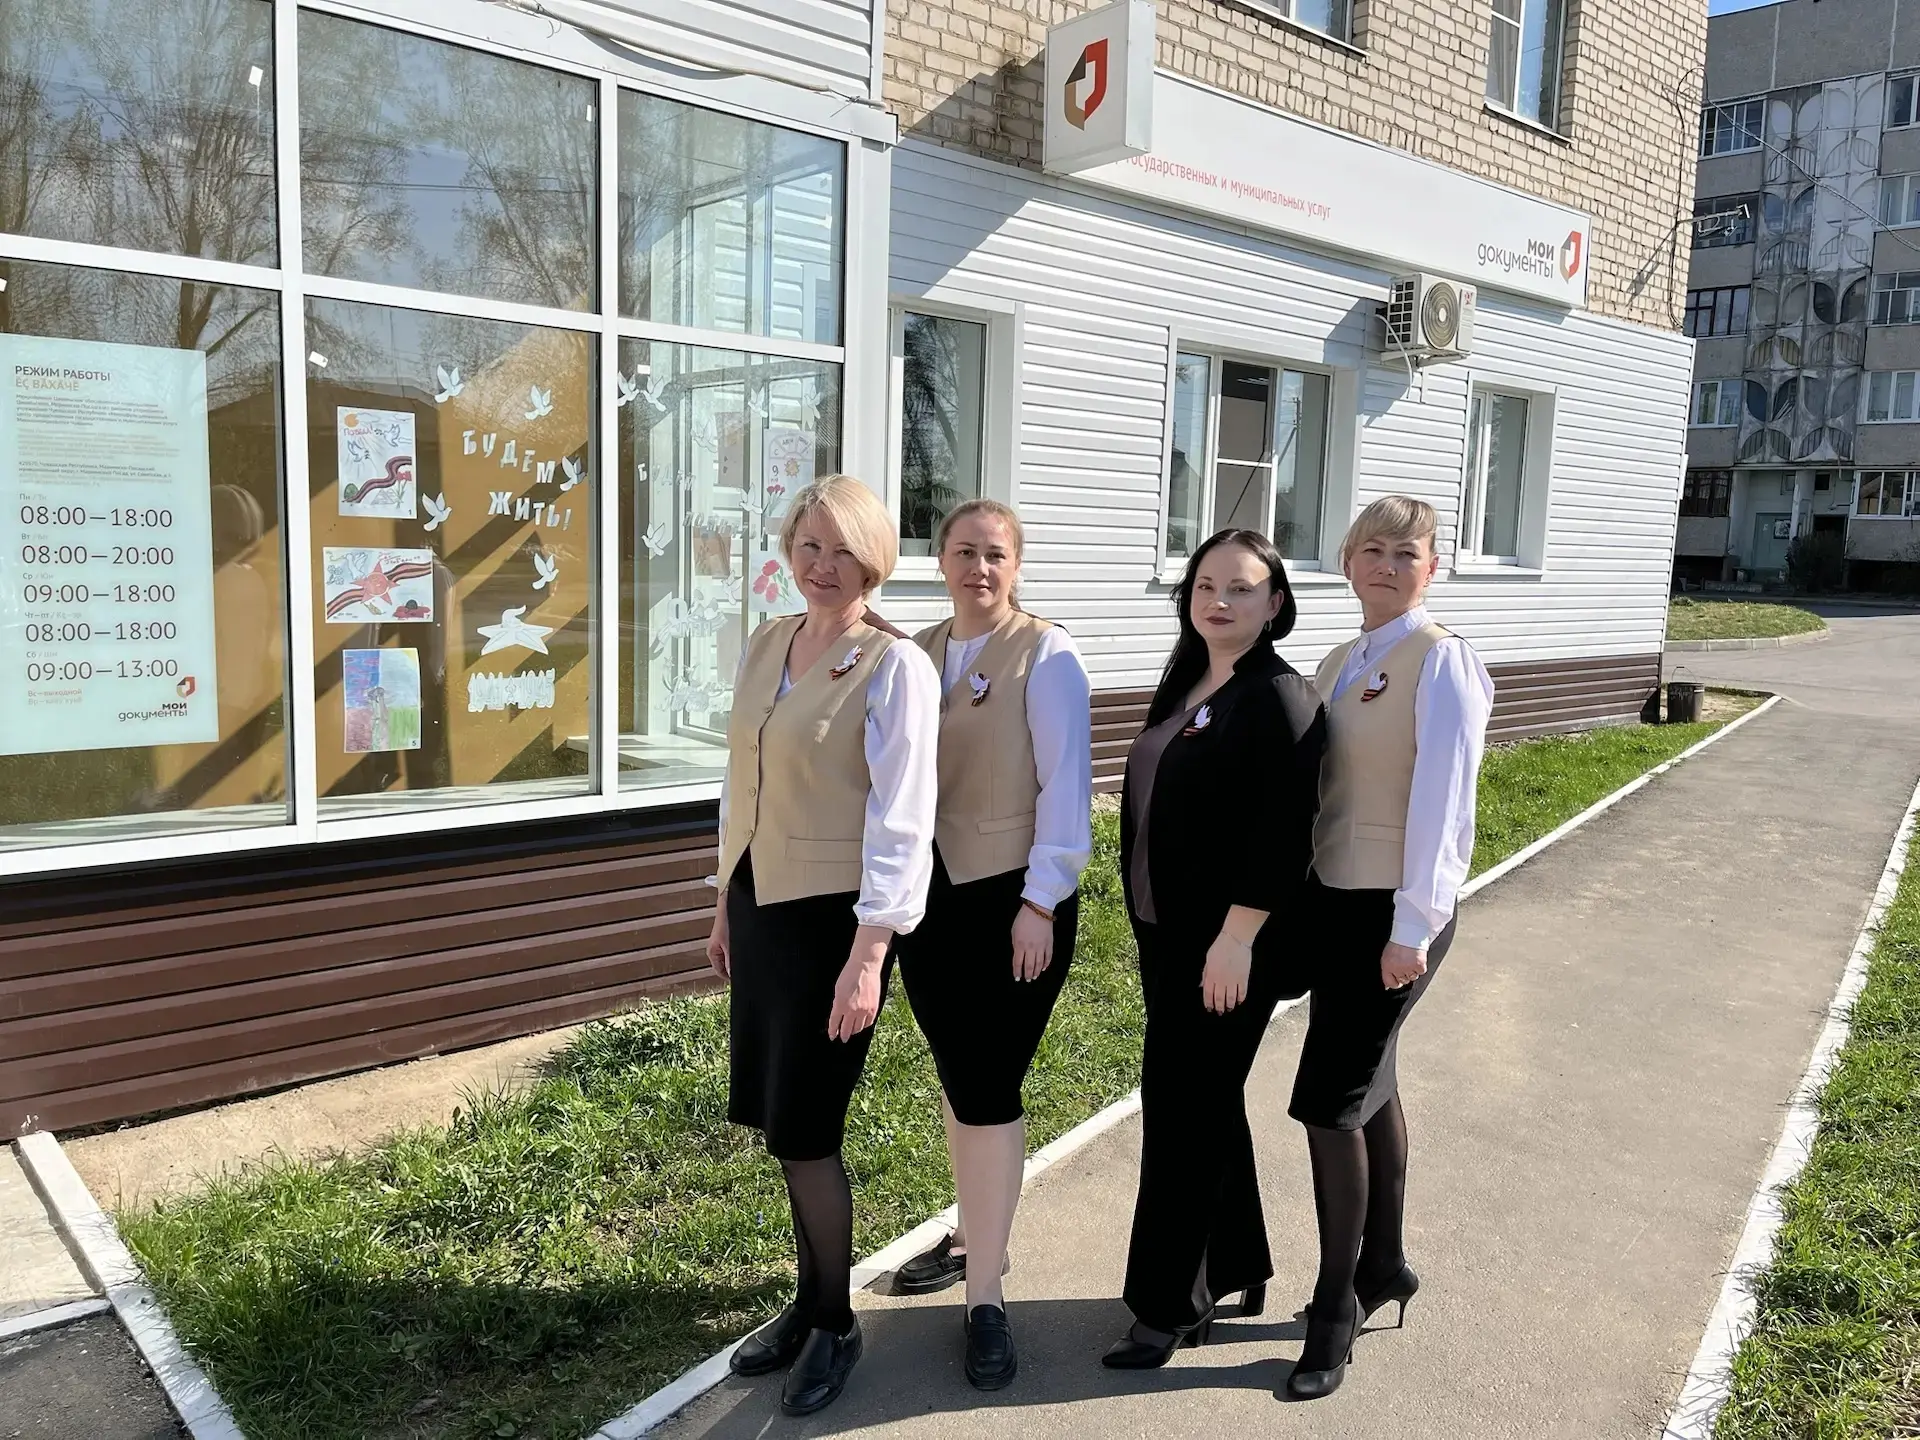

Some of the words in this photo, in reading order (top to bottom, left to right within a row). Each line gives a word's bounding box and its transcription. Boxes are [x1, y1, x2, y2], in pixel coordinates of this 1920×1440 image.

[1221, 176, 1228, 190] и
[1230, 181, 1305, 211] муниципальных
[1307, 201, 1332, 221] услуг
[1477, 242, 1554, 279] документы
[15, 365, 60, 377] РЕЖИМ
[63, 369, 111, 382] РАБОТЫ
[462, 430, 556, 483] БУДЕМ
[487, 491, 572, 531] ЖИТЬ!
[118, 709, 188, 722] документы
